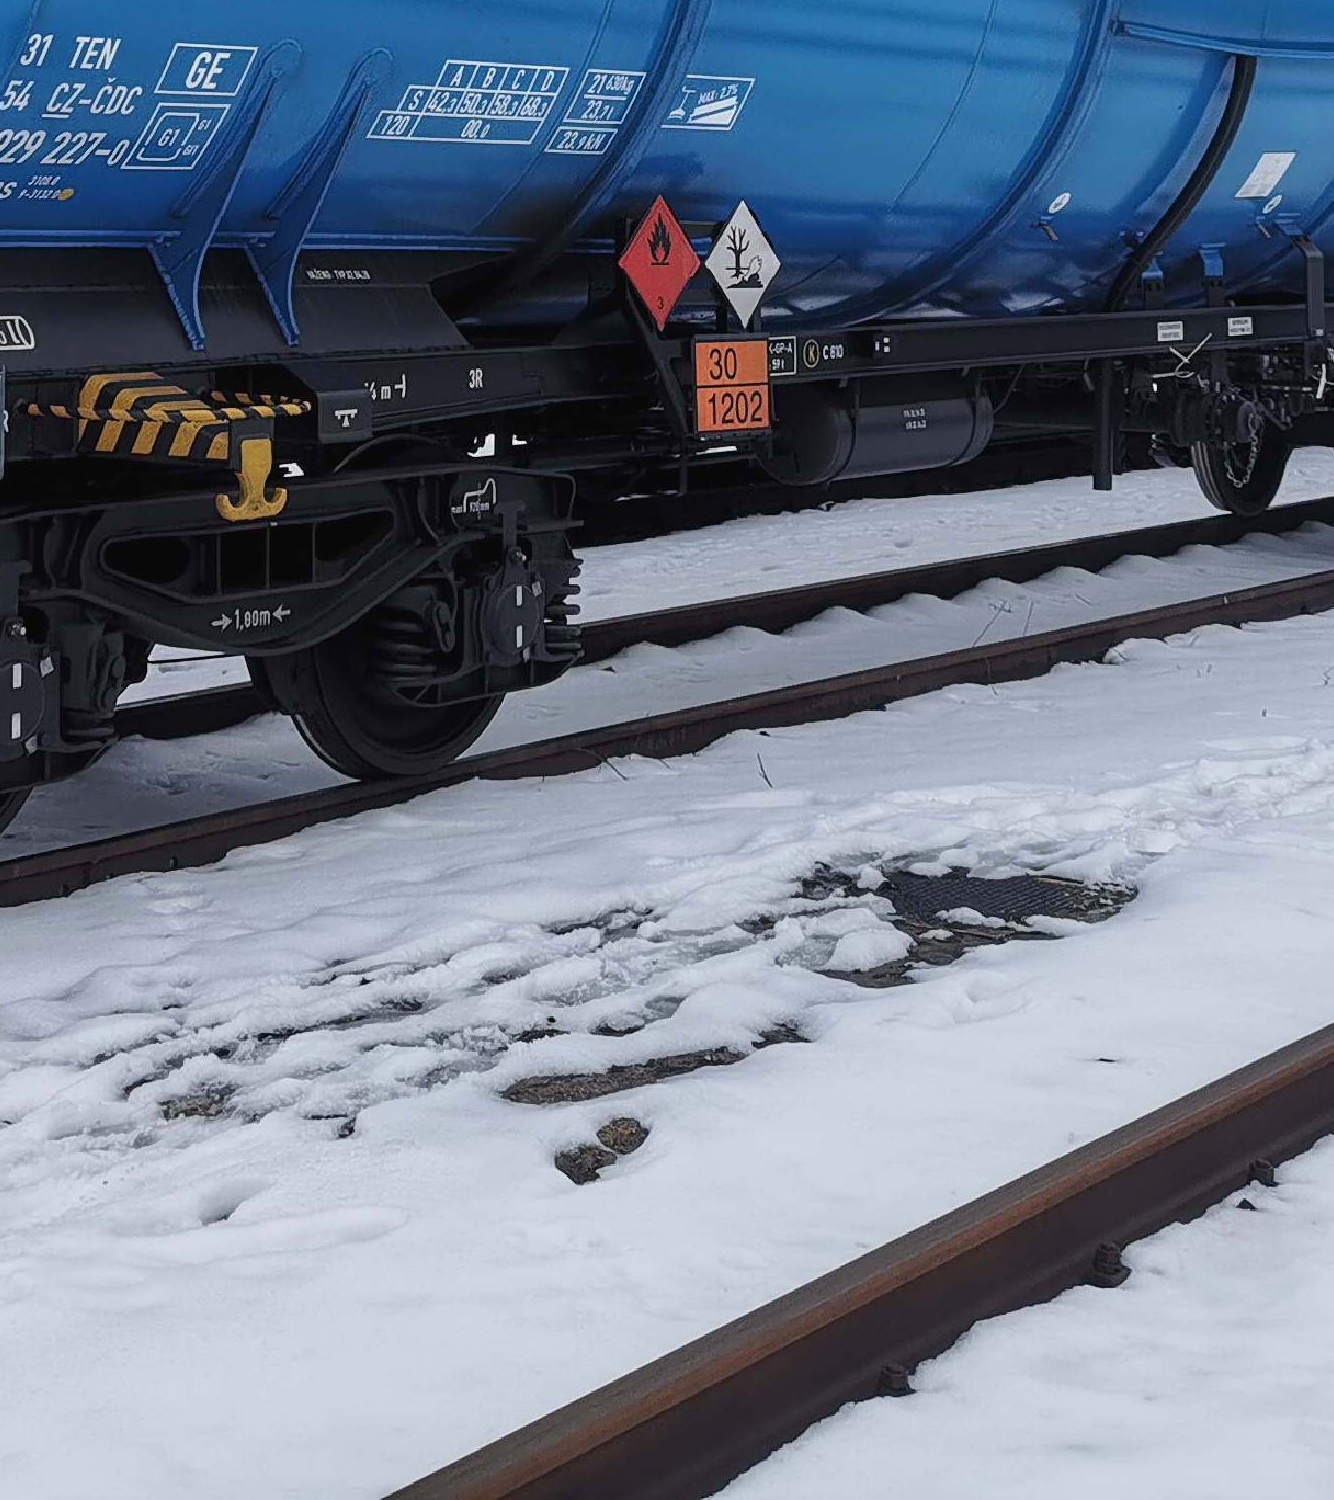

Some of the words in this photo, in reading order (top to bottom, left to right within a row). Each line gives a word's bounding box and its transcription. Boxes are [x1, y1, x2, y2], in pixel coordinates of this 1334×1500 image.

[20, 34, 54, 66] 31
[69, 36, 121, 70] TEN
[185, 52, 231, 90] GE
[450, 66, 464, 87] A
[482, 67, 497, 89] B
[511, 69, 526, 90] C
[540, 71, 555, 92] D
[46, 77, 142, 116] CZ-ČDC
[408, 90, 424, 111] S
[379, 115, 410, 136] 120
[41, 132, 130, 166] 227-0
[657, 297, 665, 310] 3
[469, 368, 483, 389] 3R
[709, 348, 738, 380] 30
[708, 392, 764, 426] 1202
